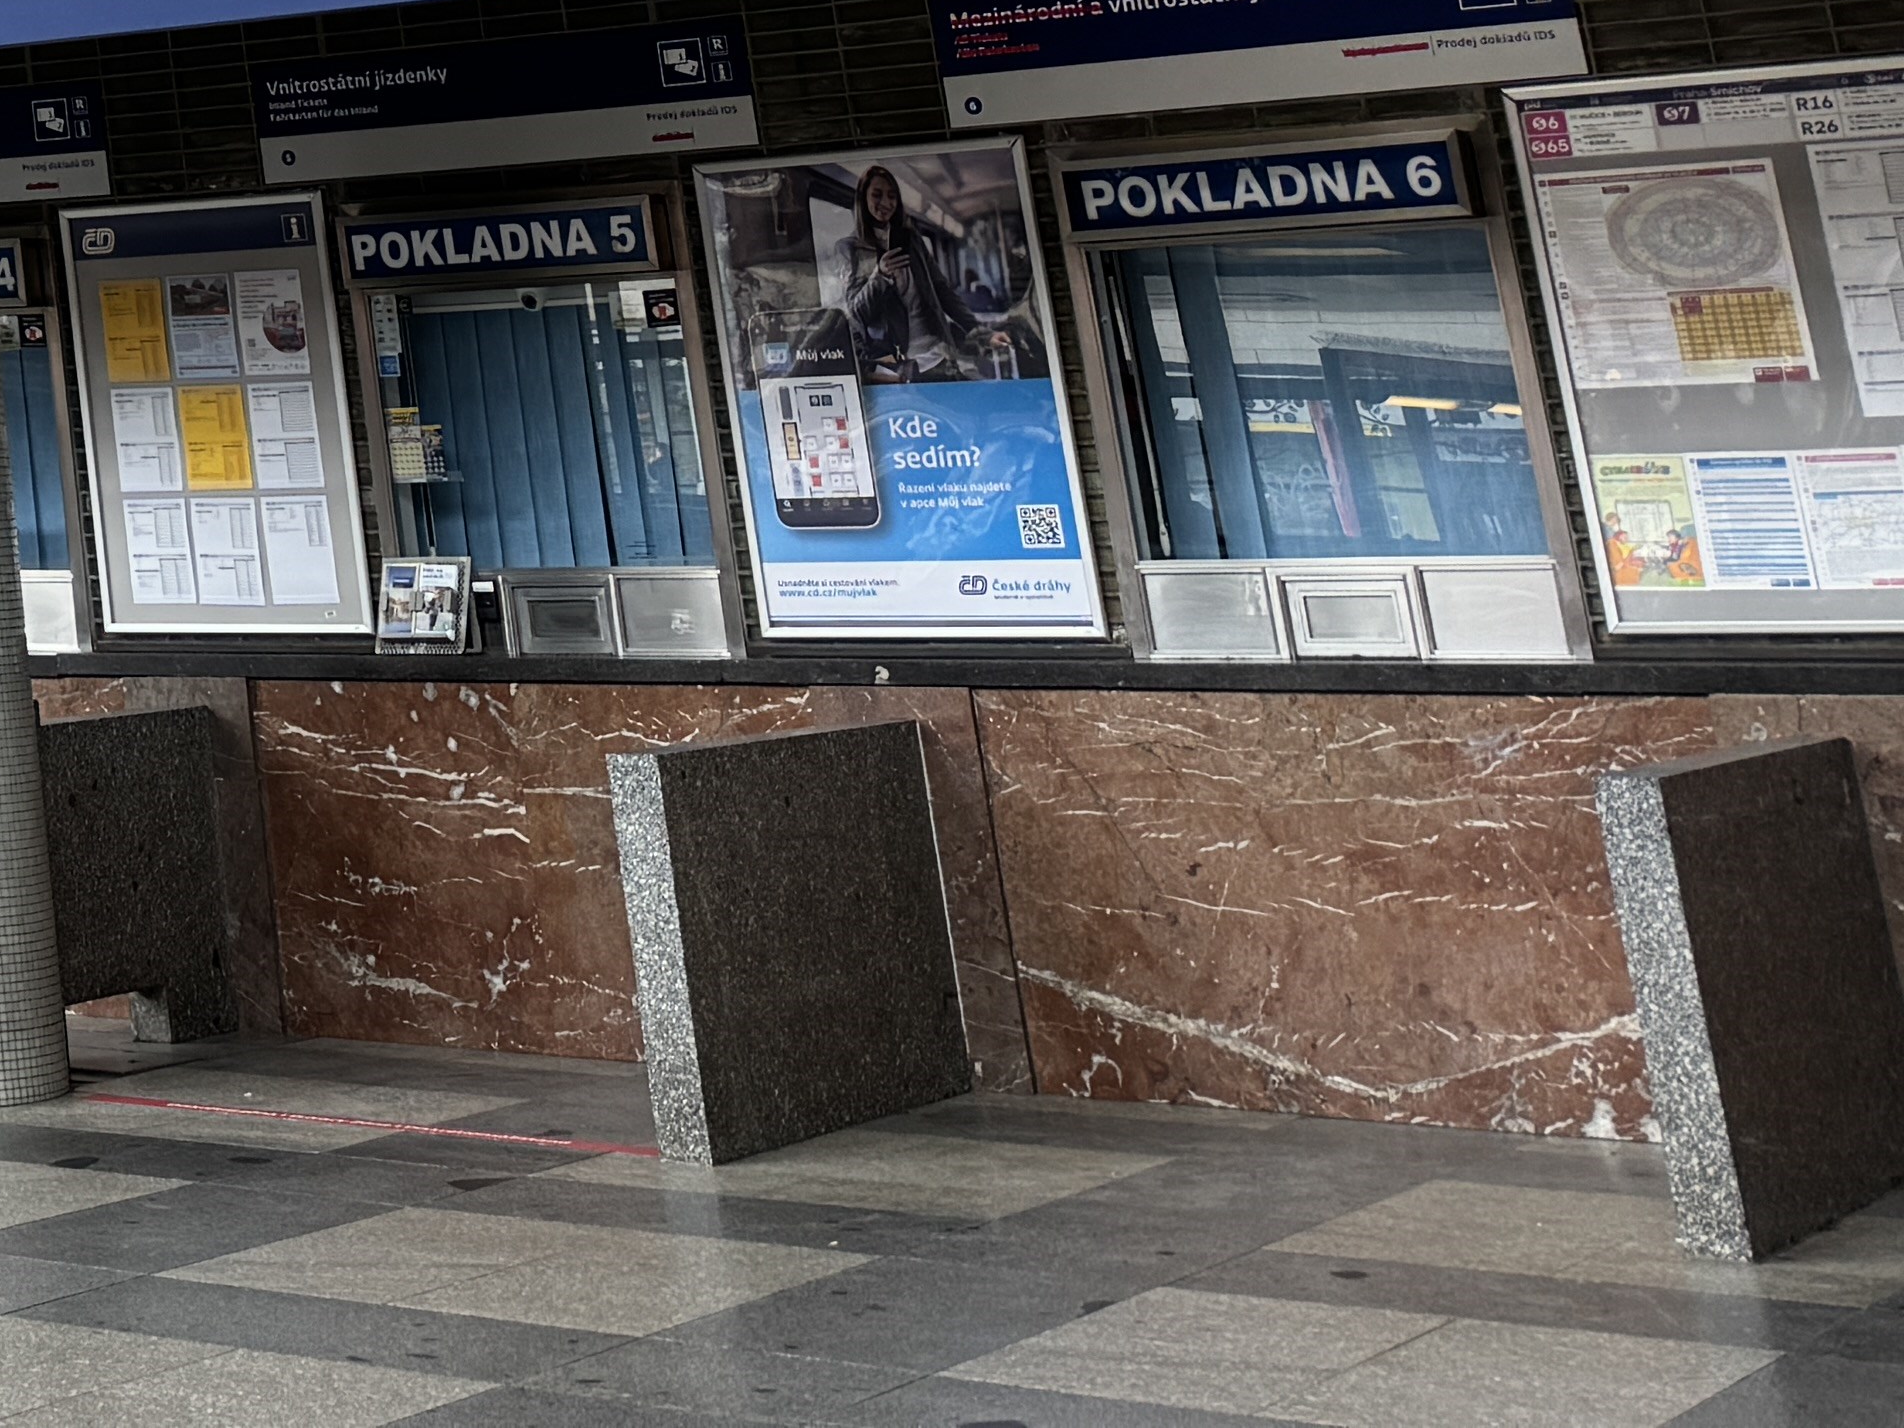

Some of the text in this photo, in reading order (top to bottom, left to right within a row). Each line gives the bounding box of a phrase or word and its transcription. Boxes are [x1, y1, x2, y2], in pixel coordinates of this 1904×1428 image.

[1436, 38, 1478, 50] Prodej
[1480, 31, 1531, 46] dokladů
[1533, 30, 1555, 41] IDS
[266, 65, 448, 96] Vnitrostátní jízdenky
[1795, 95, 1833, 112] R16
[1801, 119, 1839, 135] R26
[1081, 155, 1442, 221] POKLADNA 6
[351, 214, 636, 271] POKLADNA 5
[796, 348, 845, 363] Můj vlak
[888, 415, 938, 439] Kde
[893, 444, 981, 469] sedím?
[898, 481, 1012, 495] Řazení vlaku najdete
[900, 499, 907, 508] v
[910, 498, 935, 509] apce
[938, 495, 959, 509] Můj
[779, 588, 878, 599] www.cd.cz/mujvlak
[992, 578, 1030, 592] České
[1033, 579, 1071, 594] dráhy
